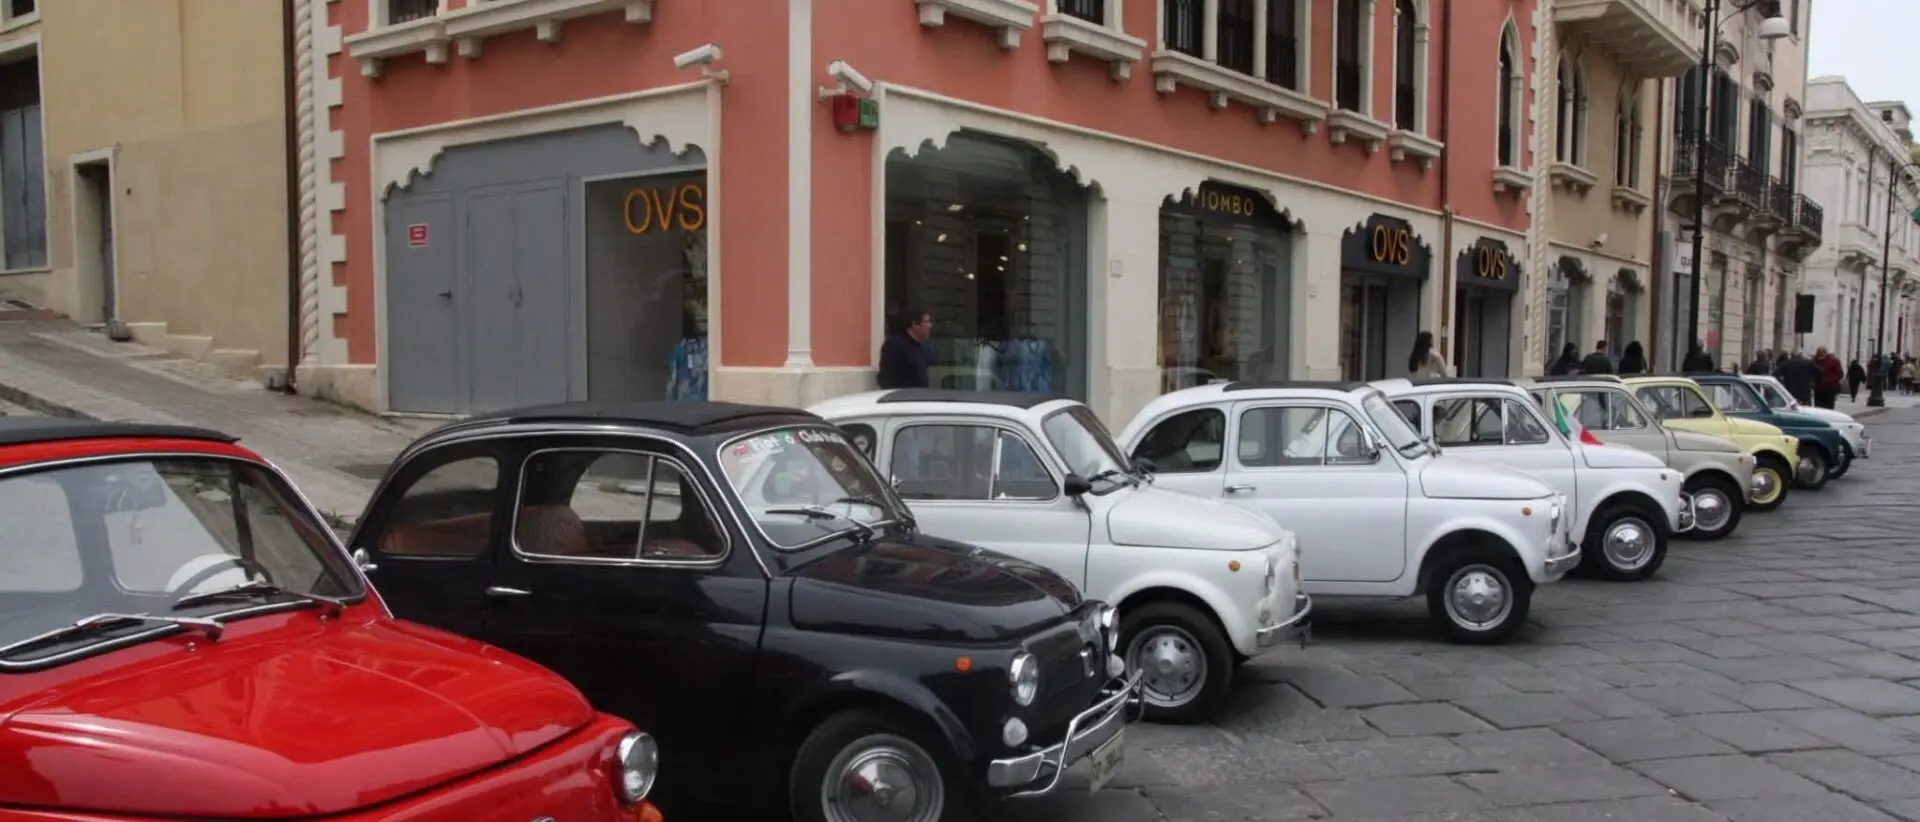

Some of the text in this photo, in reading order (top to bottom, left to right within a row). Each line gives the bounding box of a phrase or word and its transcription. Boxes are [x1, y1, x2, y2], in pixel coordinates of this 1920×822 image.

[623, 183, 704, 234] OVS
[1373, 224, 1409, 266] OVS
[1478, 245, 1506, 280] OVS
[798, 430, 824, 443] Club
